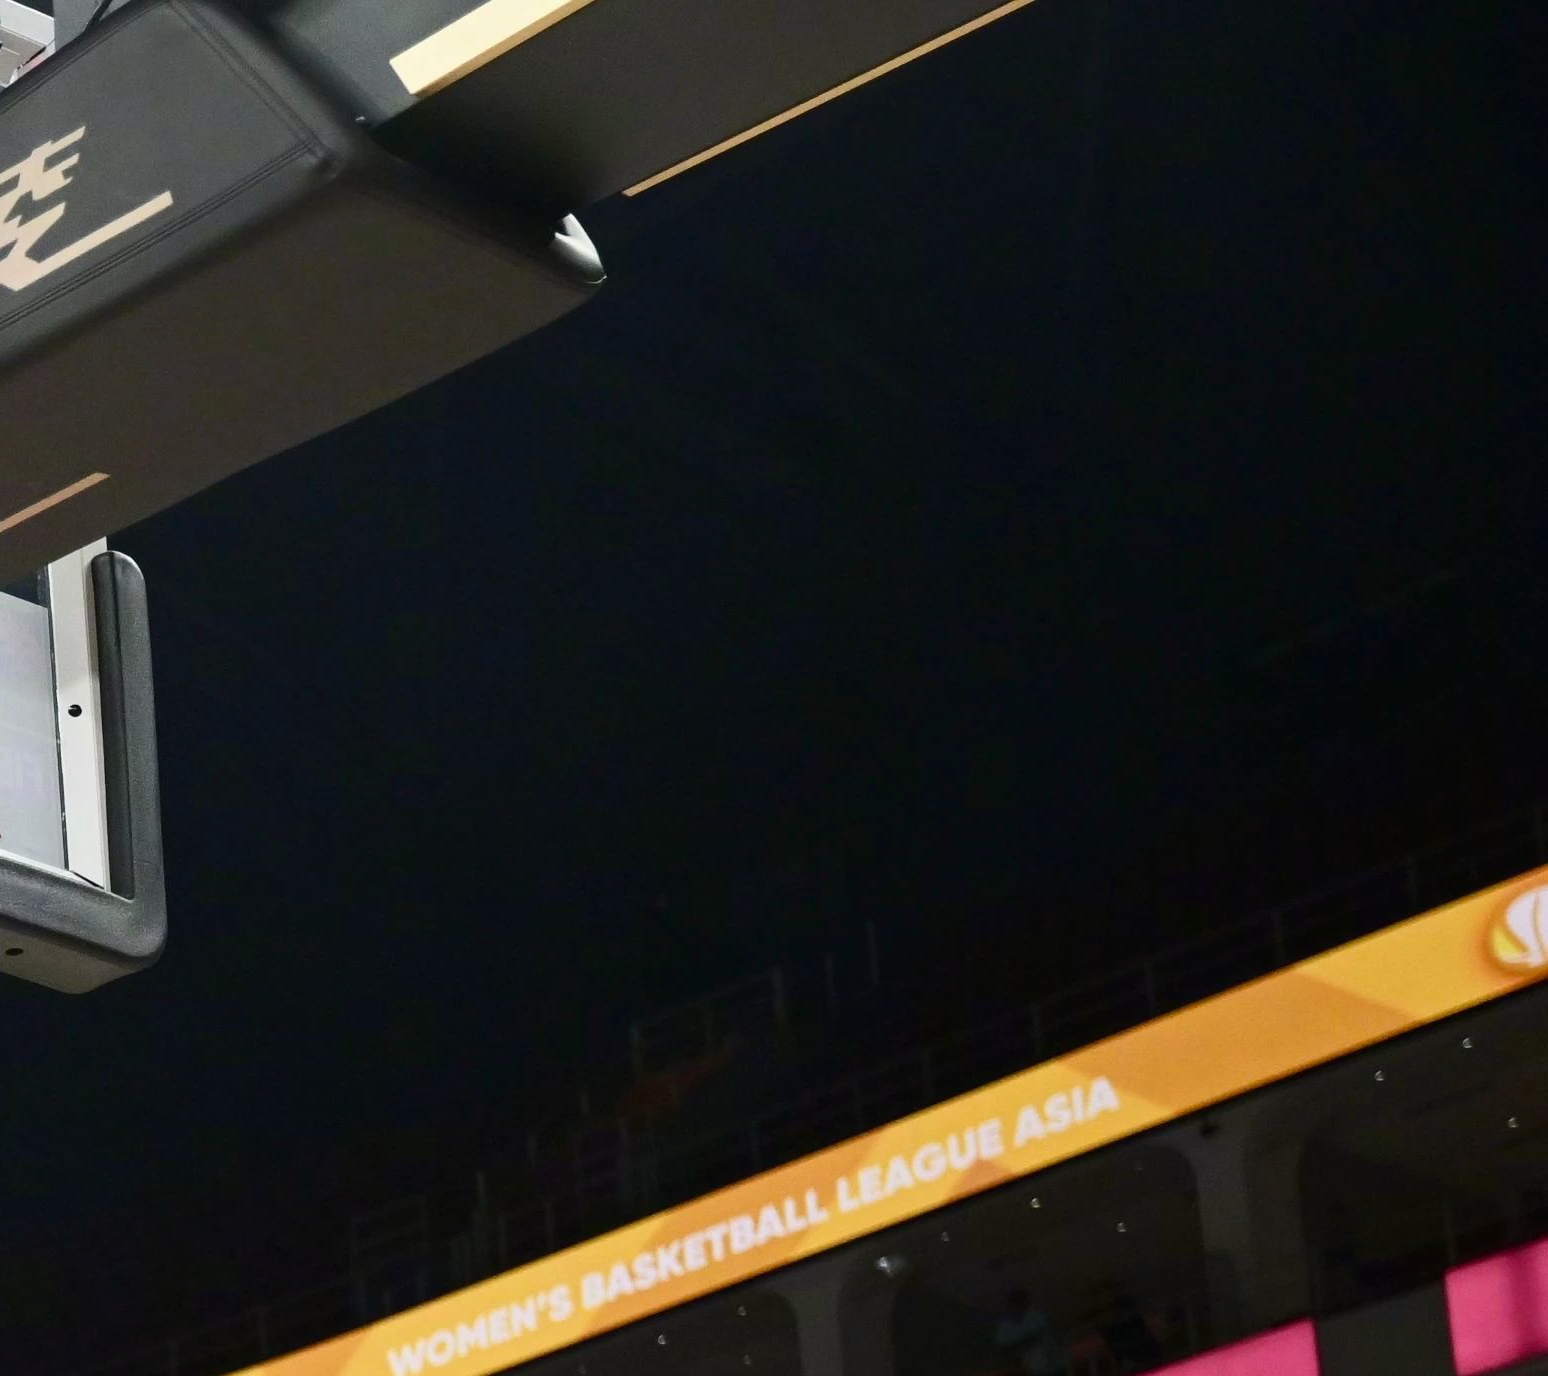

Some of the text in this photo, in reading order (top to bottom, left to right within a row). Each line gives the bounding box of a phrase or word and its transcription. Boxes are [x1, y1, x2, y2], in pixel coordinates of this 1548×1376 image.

[582, 1190, 830, 1309] BASKETBALL
[836, 1117, 1005, 1213] LEAGUE
[1013, 1075, 1121, 1149] ASIA
